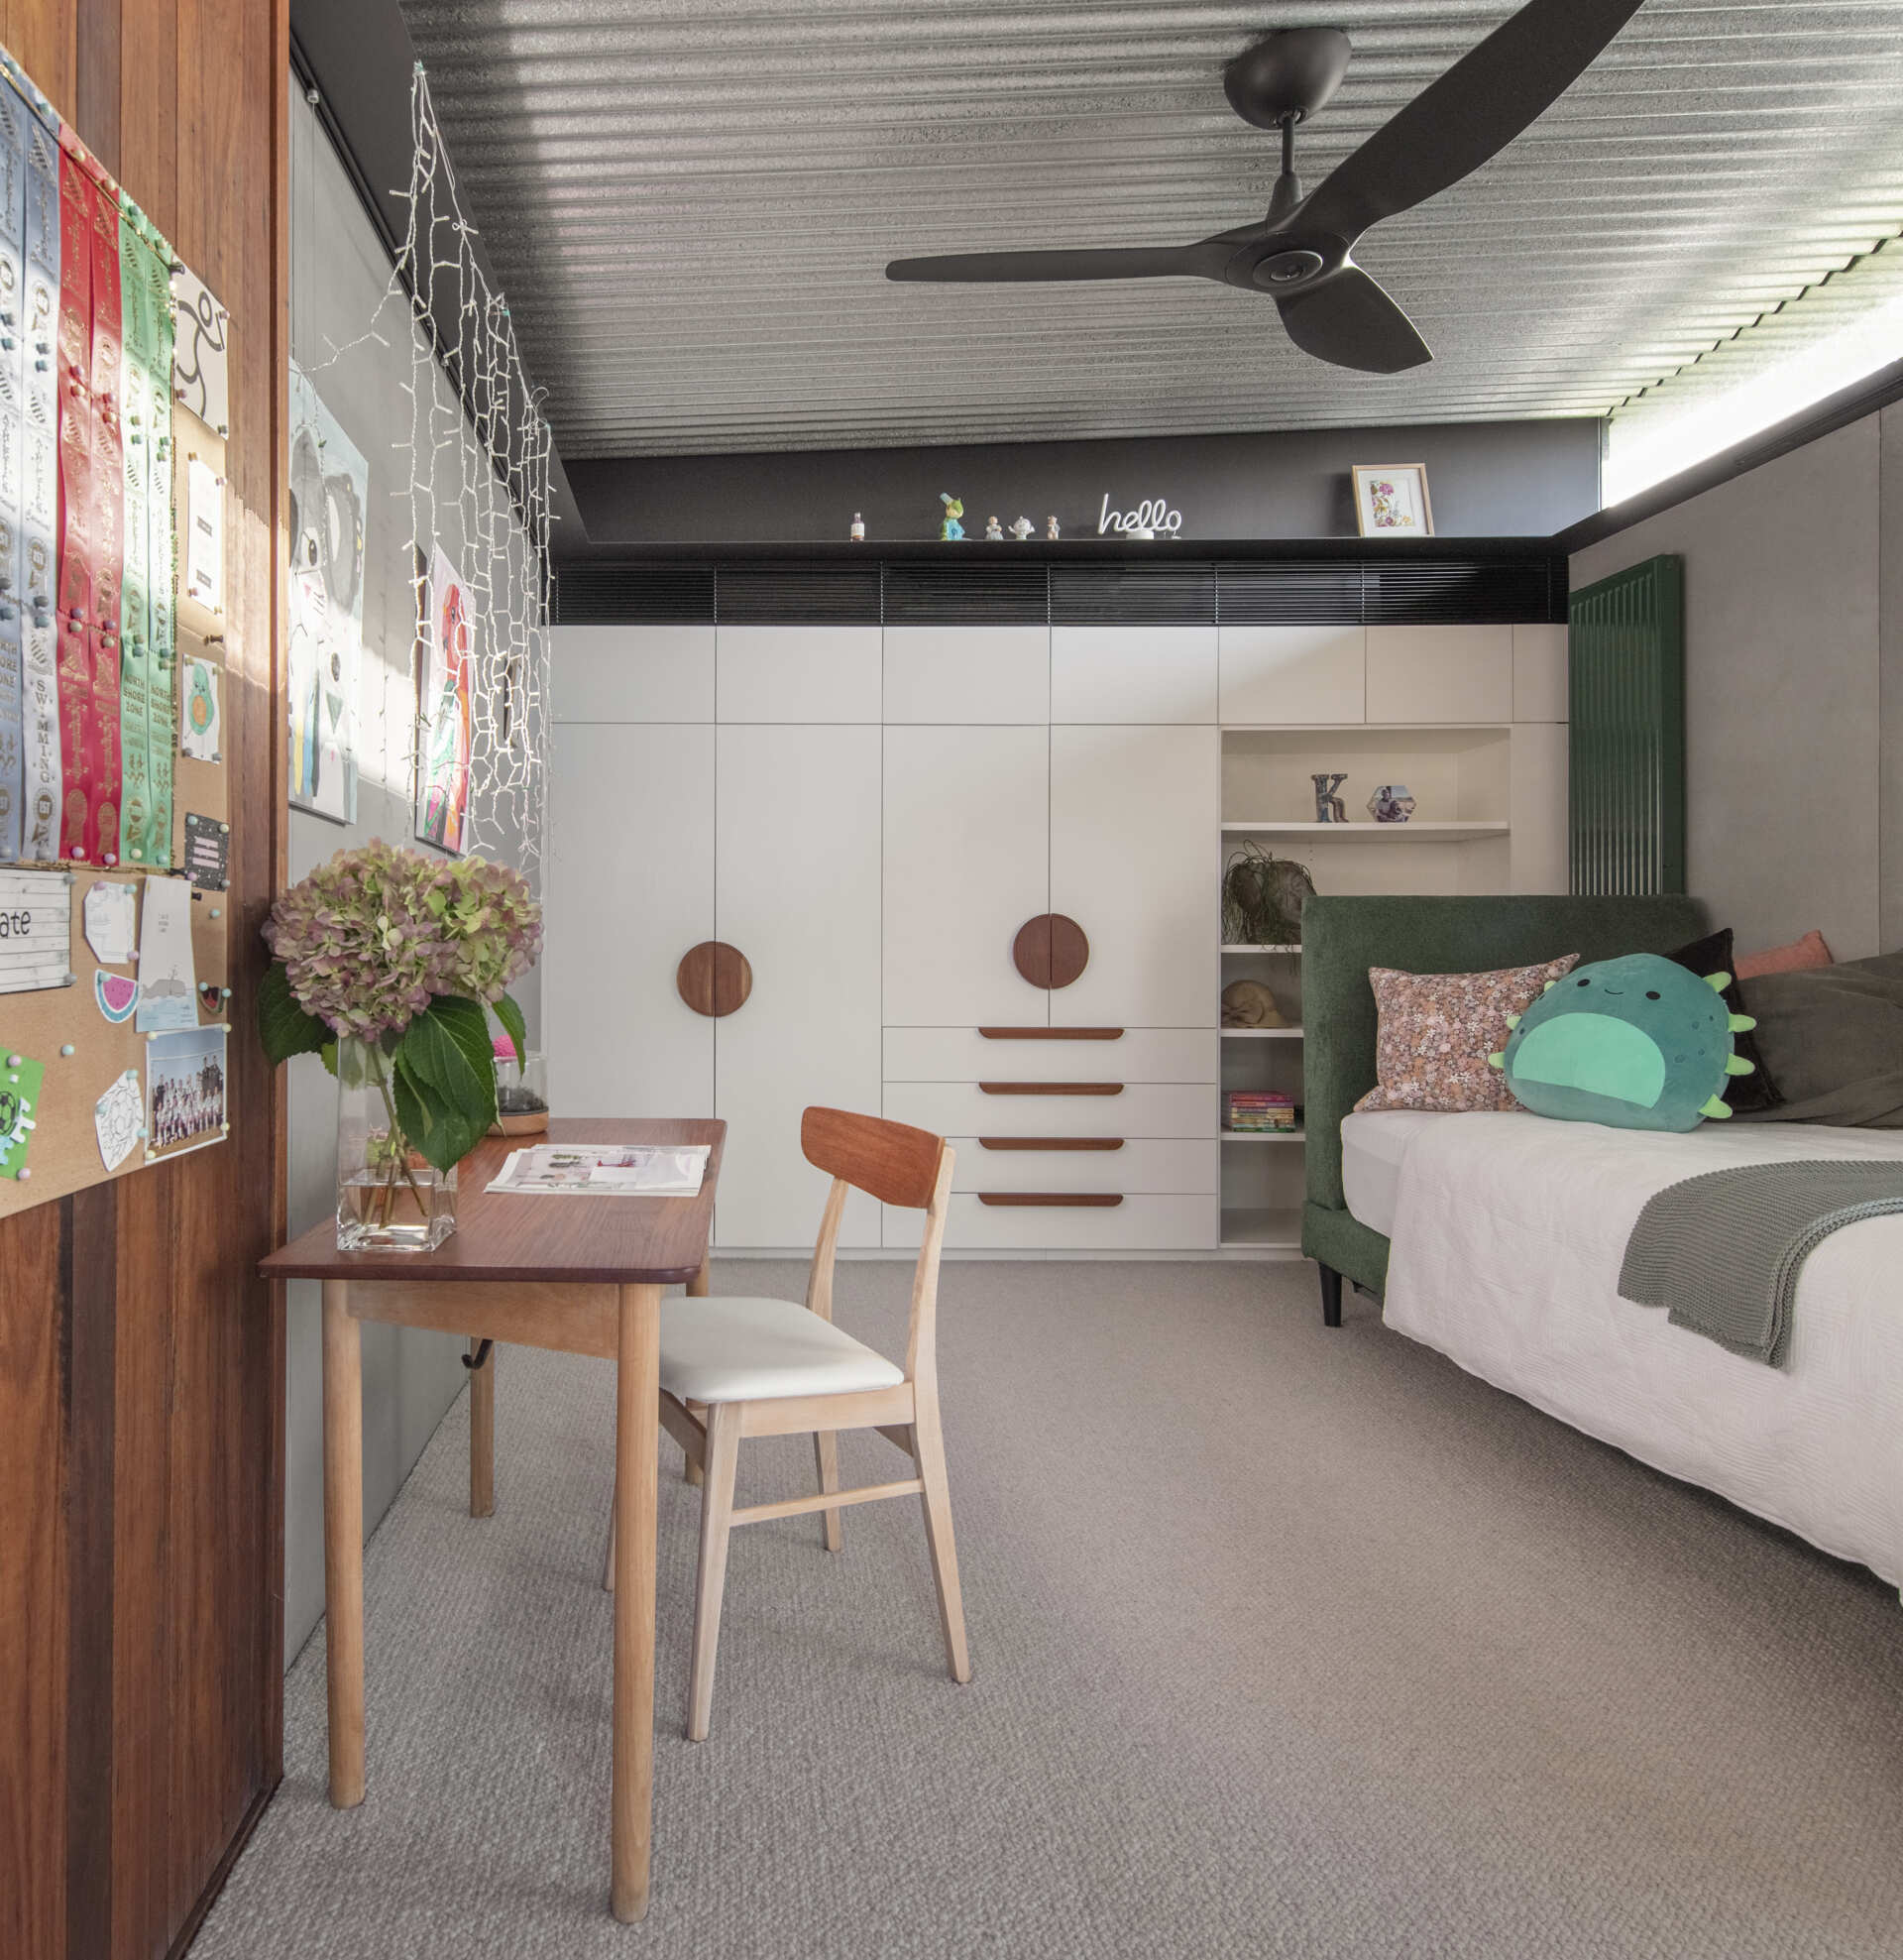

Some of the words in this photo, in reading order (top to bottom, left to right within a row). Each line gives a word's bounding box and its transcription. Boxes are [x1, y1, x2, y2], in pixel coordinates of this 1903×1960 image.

[1098, 492, 1182, 535] hello
[36, 679, 52, 784] SWIMMING
[1310, 772, 1350, 824] K
